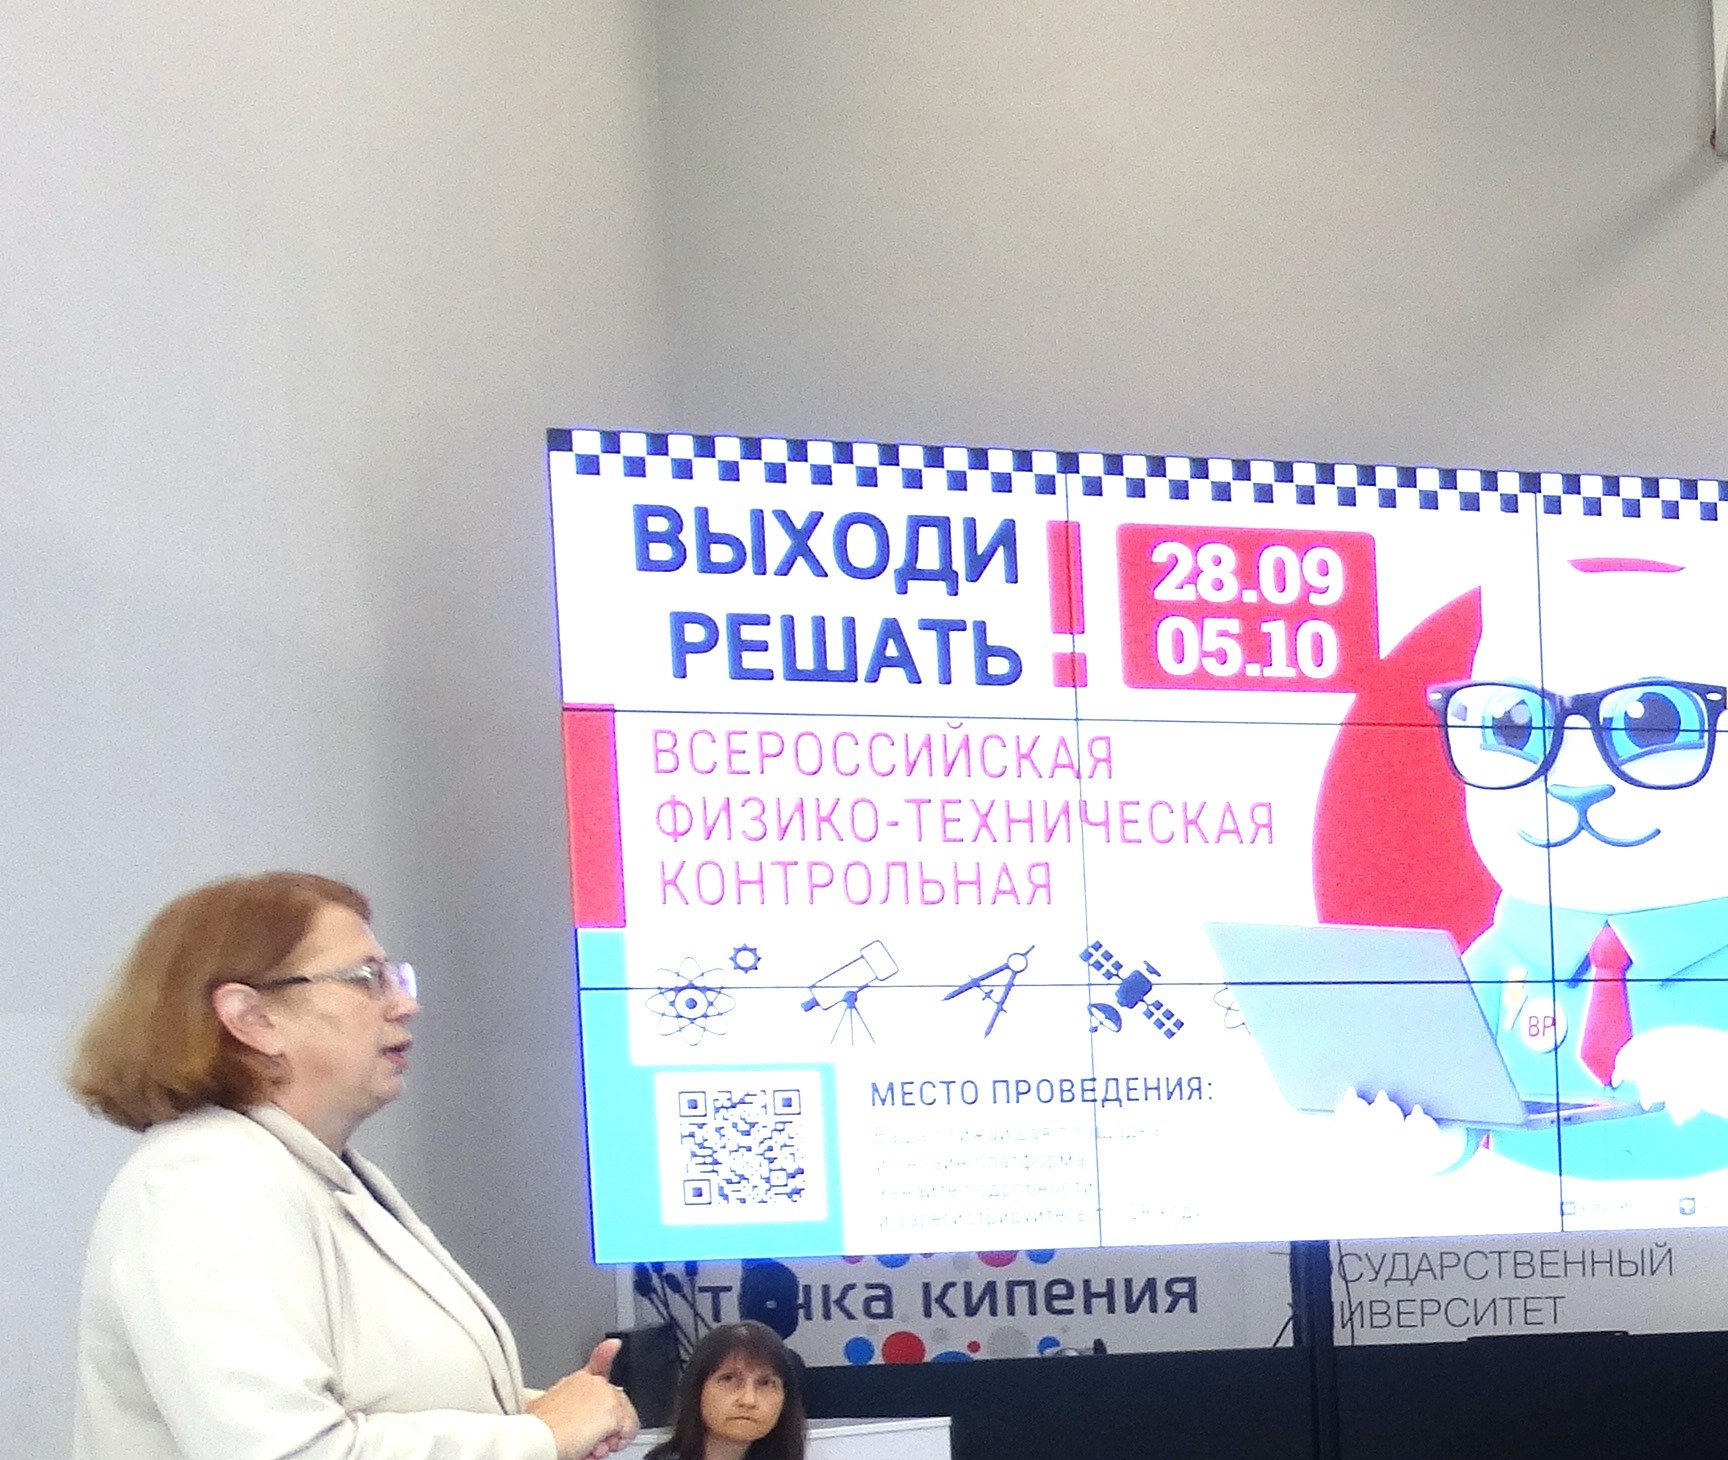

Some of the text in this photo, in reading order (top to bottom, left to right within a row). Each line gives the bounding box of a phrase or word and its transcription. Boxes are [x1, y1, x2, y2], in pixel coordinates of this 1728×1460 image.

[631, 502, 1020, 598] ВЫХОДИ
[1151, 541, 1345, 607] 28.09
[669, 610, 1024, 688] РЕШАТЬ
[1155, 618, 1339, 680] 05.10
[651, 723, 1114, 781] ВСЕРОССИЙСКАЯ
[655, 794, 1275, 846] ФИЗИКО-ТЕХНИЧЕСКАЯ
[659, 859, 1053, 907] КОНТРОЛЬНАЯ
[871, 1076, 1213, 1107] МЕСТО ПРОВЕДЕНИЯ:
[1337, 1242, 1674, 1289] СУДАРСТВЕННЫЙ
[698, 1275, 1199, 1324] тчка кипения
[1339, 1295, 1567, 1330] ИВЕРСИТЕТ
